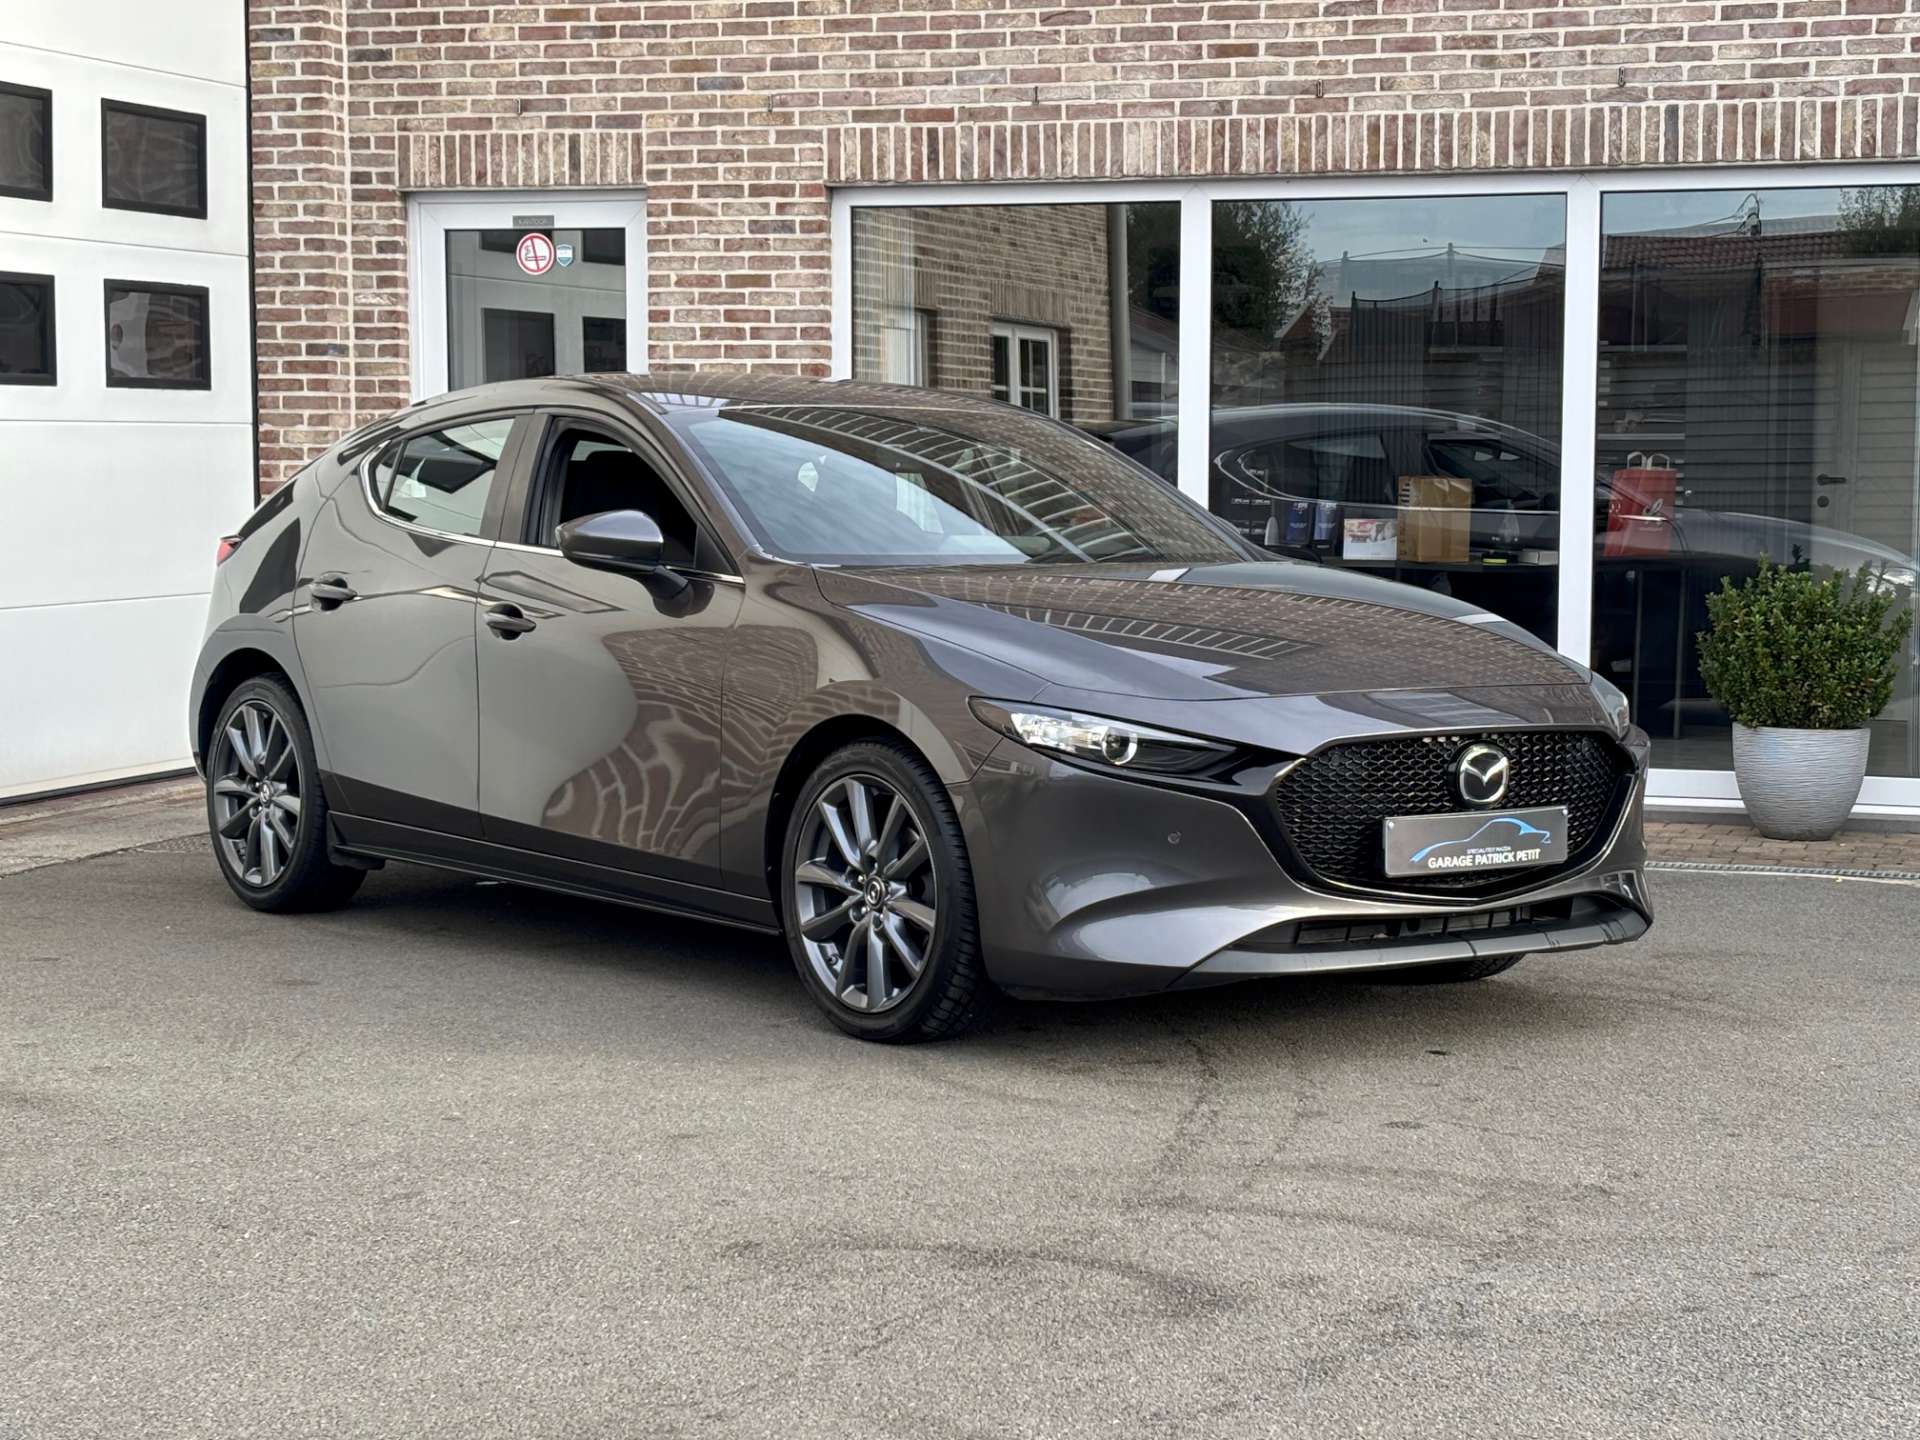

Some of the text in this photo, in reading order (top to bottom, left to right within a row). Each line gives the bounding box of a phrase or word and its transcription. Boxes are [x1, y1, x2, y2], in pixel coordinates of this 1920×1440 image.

[1428, 848, 1541, 868] GARAGE PATRICK PETIT
